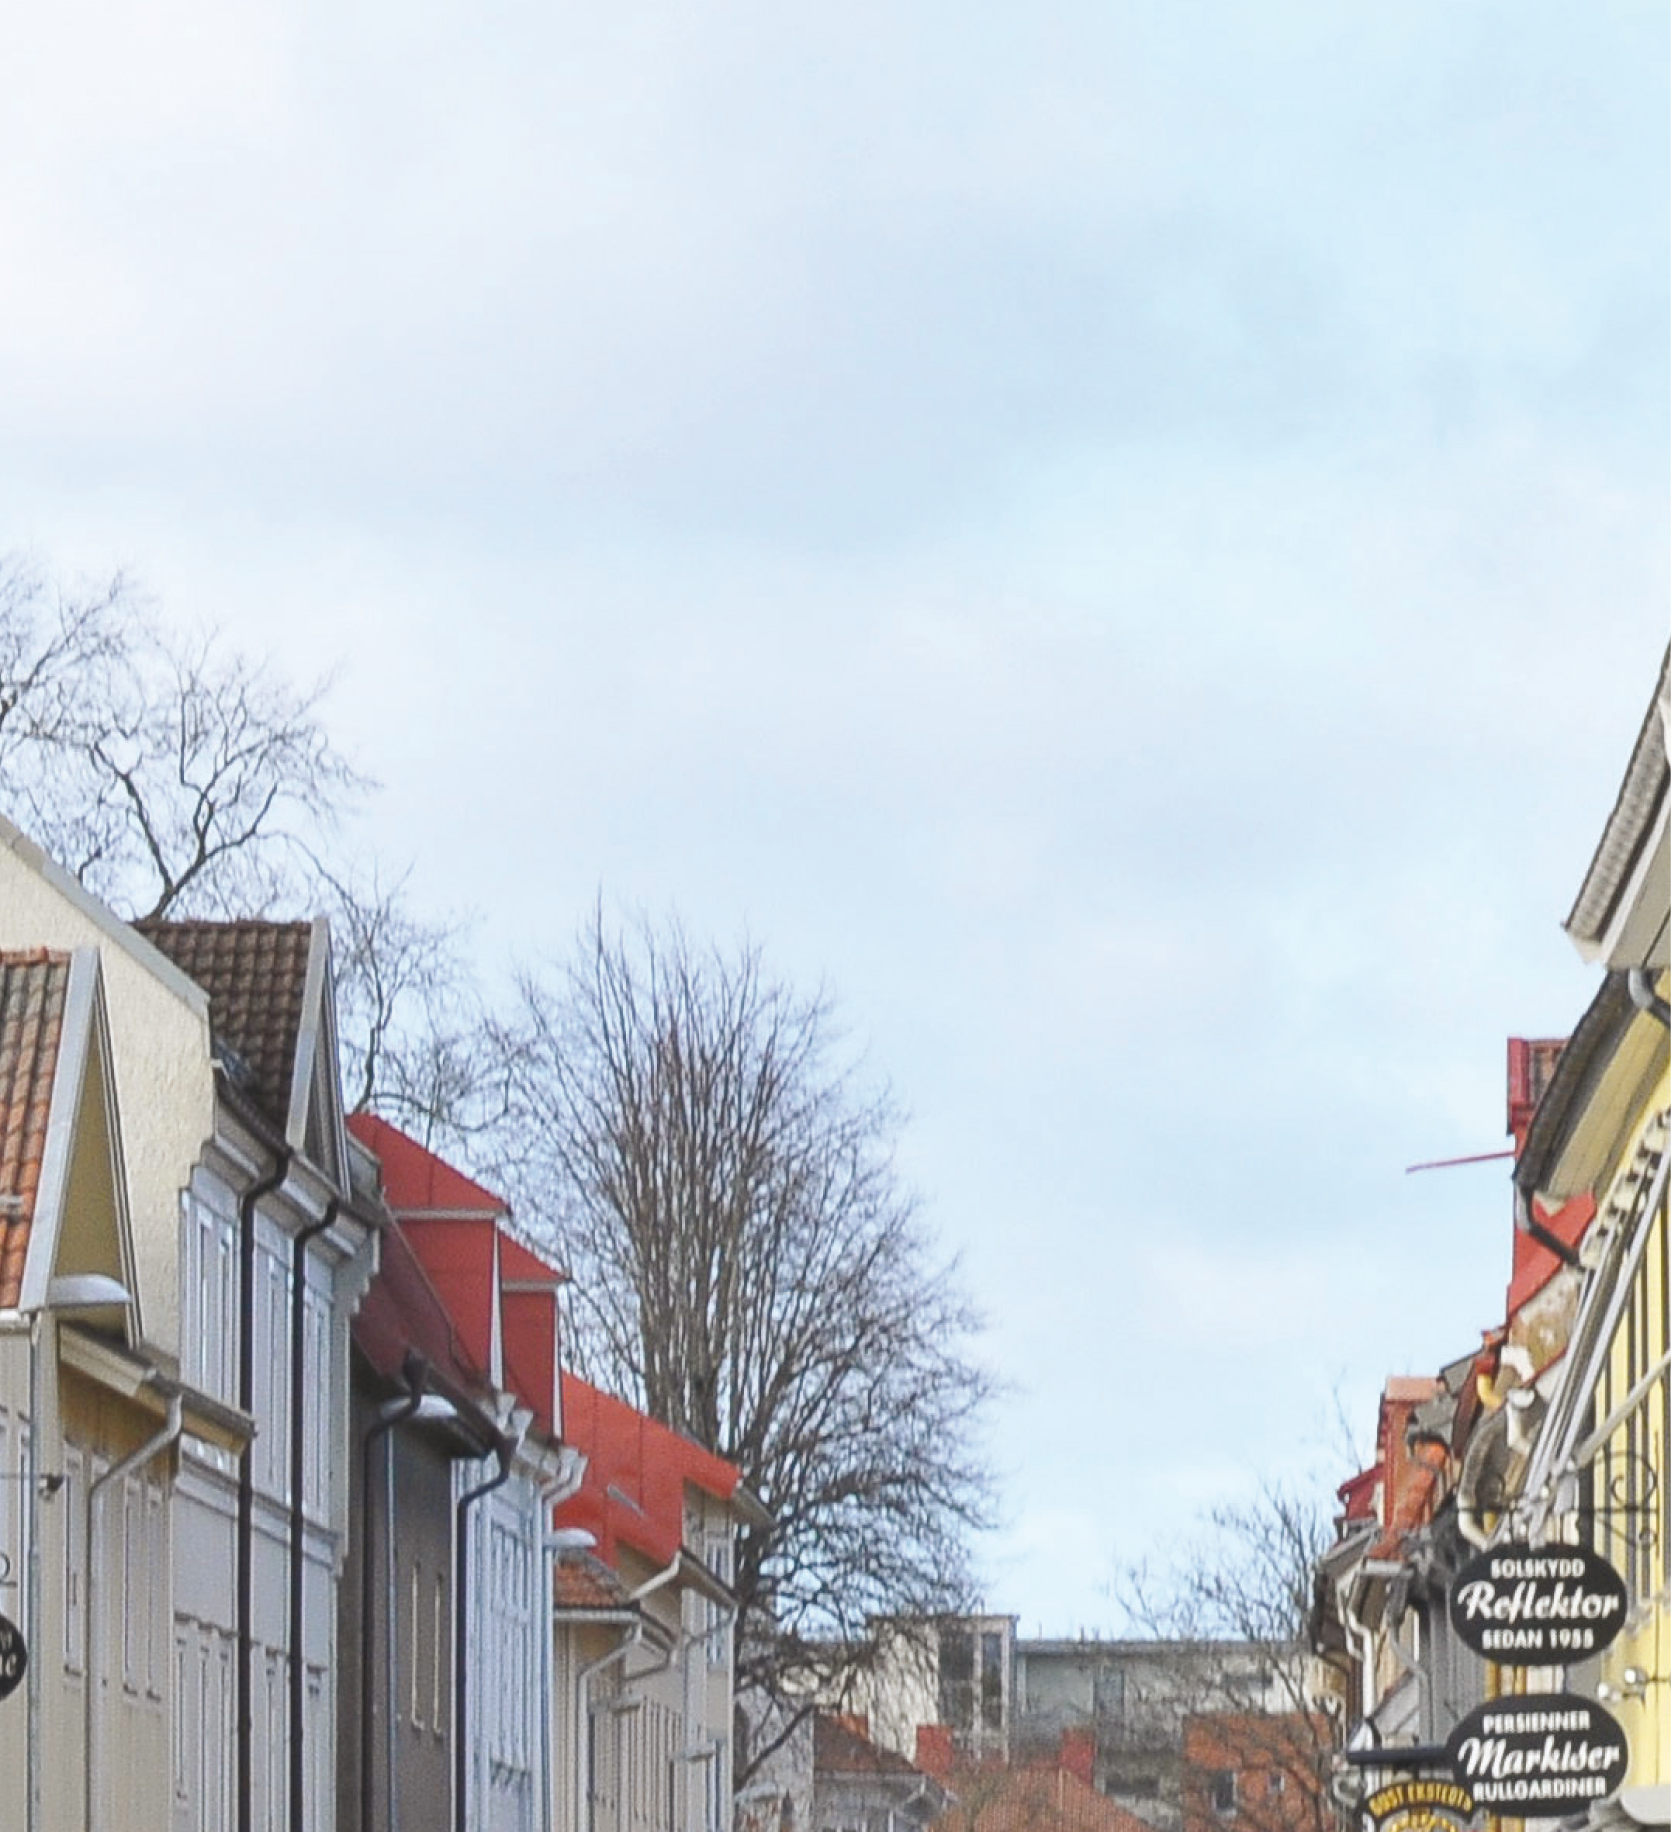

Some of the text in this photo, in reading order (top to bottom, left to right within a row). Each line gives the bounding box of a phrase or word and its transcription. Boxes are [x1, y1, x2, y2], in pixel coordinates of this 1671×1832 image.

[1491, 1558, 1585, 1579] SOLSKYDD
[1457, 1580, 1619, 1625] Reflektor
[1482, 1628, 1544, 1650] SEDAN
[1483, 1711, 1590, 1735] PERSIENNER
[1457, 1734, 1620, 1779] Markiser
[1473, 1776, 1606, 1802] RULLGARDINER
